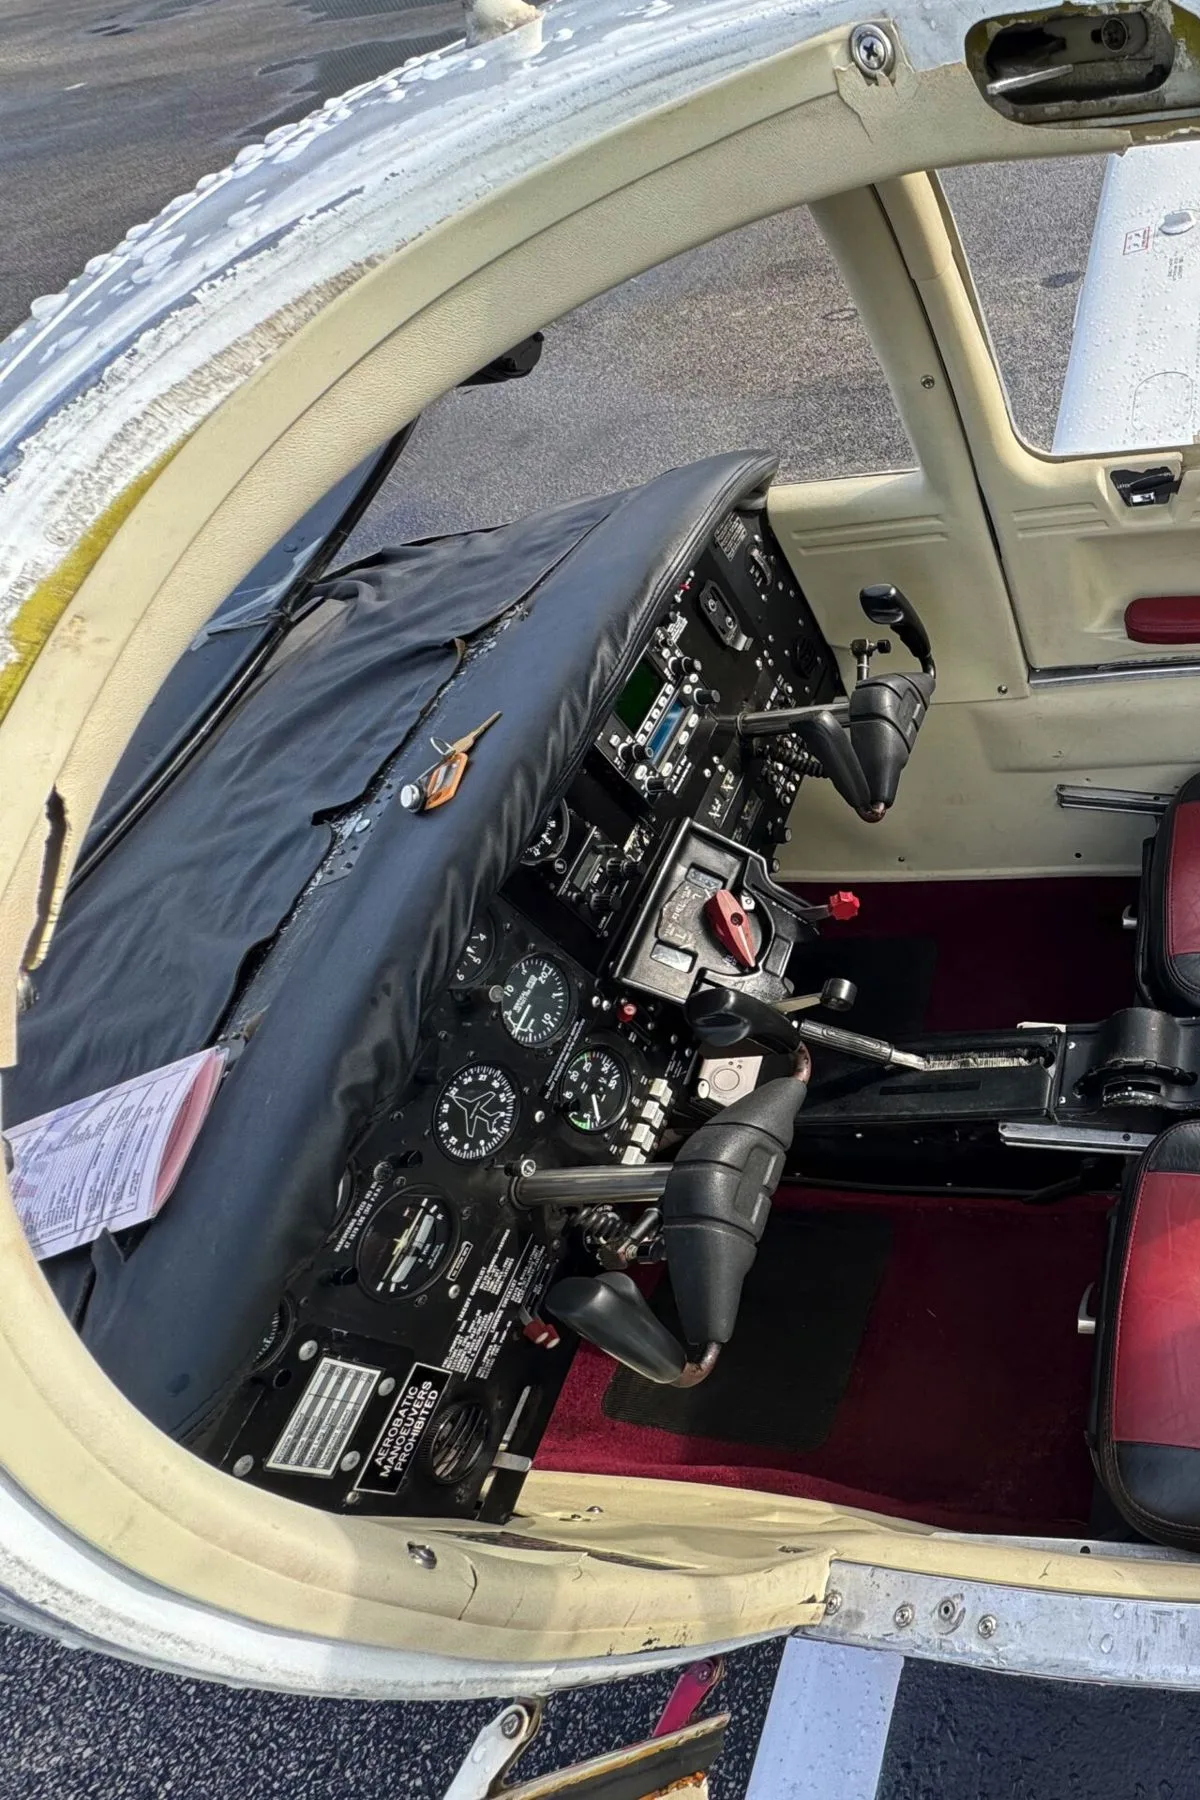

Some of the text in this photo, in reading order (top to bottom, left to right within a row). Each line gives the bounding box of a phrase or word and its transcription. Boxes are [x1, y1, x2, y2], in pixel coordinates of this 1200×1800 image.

[479, 933, 487, 942] 4
[456, 972, 465, 982] 6
[538, 970, 552, 985] 20
[503, 984, 514, 997] 10
[541, 1012, 552, 1026] 10
[582, 1062, 592, 1073] 25
[569, 1070, 579, 1082] 20
[375, 1386, 418, 1466] AEROBATIC
[380, 1381, 432, 1477] MANOEUVERS
[394, 1390, 438, 1471] PROHIBITED
